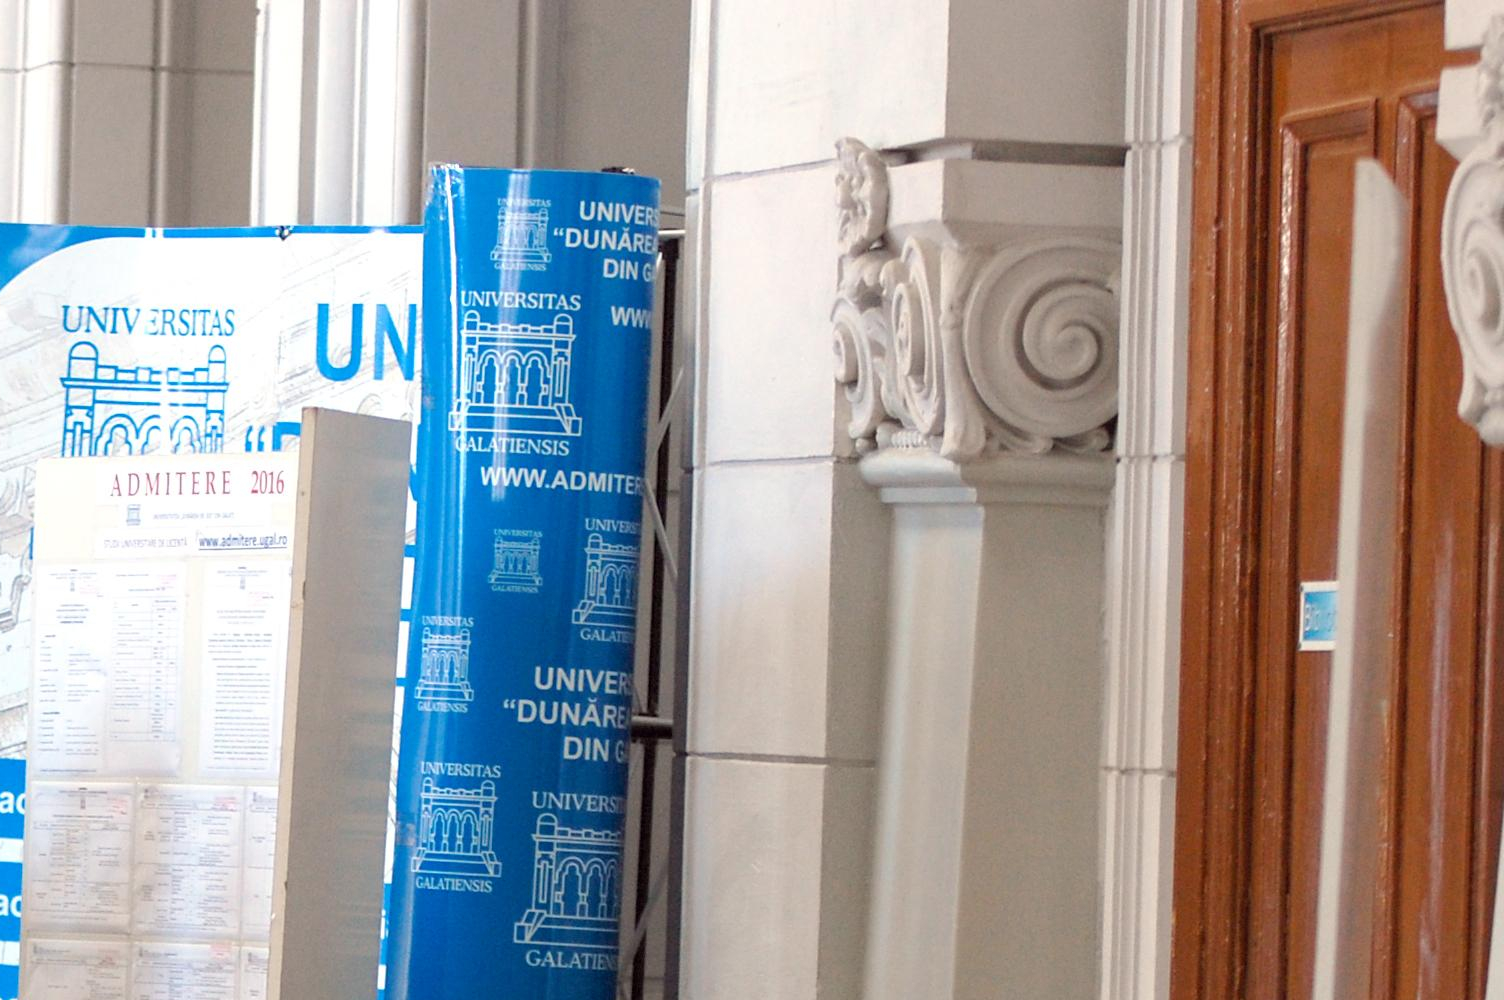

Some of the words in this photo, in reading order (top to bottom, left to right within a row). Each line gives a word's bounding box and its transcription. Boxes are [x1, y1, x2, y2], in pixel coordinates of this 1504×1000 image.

[602, 258, 639, 281] DIN
[642, 266, 656, 282] G
[460, 290, 582, 311] UNIVERSITAS
[62, 305, 236, 337] UNIVERSITAS
[455, 437, 570, 456] GALATIENSIS
[110, 470, 232, 497] ADMITERE
[250, 470, 285, 494] 2016
[198, 533, 288, 548] www.admitere.ugal.ro
[421, 616, 475, 628] UNIVERSITAS
[563, 736, 609, 762] DIN
[420, 762, 501, 778] UNIVERSITAS
[415, 877, 493, 894] GALATIENSIS
